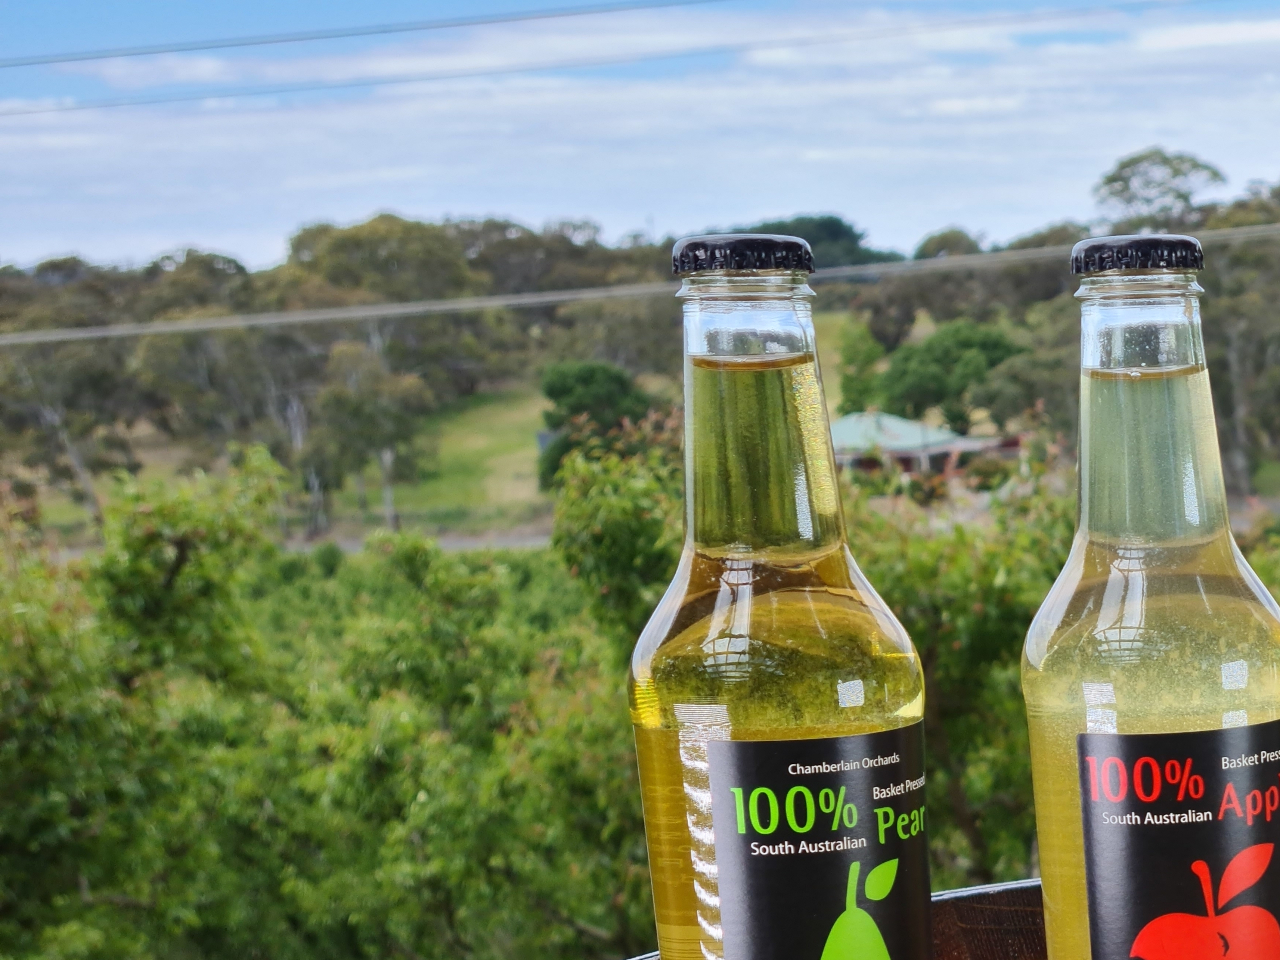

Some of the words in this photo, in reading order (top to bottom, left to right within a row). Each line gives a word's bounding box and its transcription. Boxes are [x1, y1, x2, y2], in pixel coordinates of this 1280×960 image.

[788, 760, 860, 775] Chamberlain
[861, 752, 900, 769] Orchards
[1221, 753, 1259, 769] Basket
[1086, 756, 1205, 803] 100%
[872, 785, 905, 800] Basket
[730, 786, 858, 834] 100%
[1102, 812, 1140, 824] South
[1144, 810, 1213, 824] Australian
[874, 805, 925, 844] Pear
[750, 842, 795, 856] South
[798, 836, 867, 854] Australian
